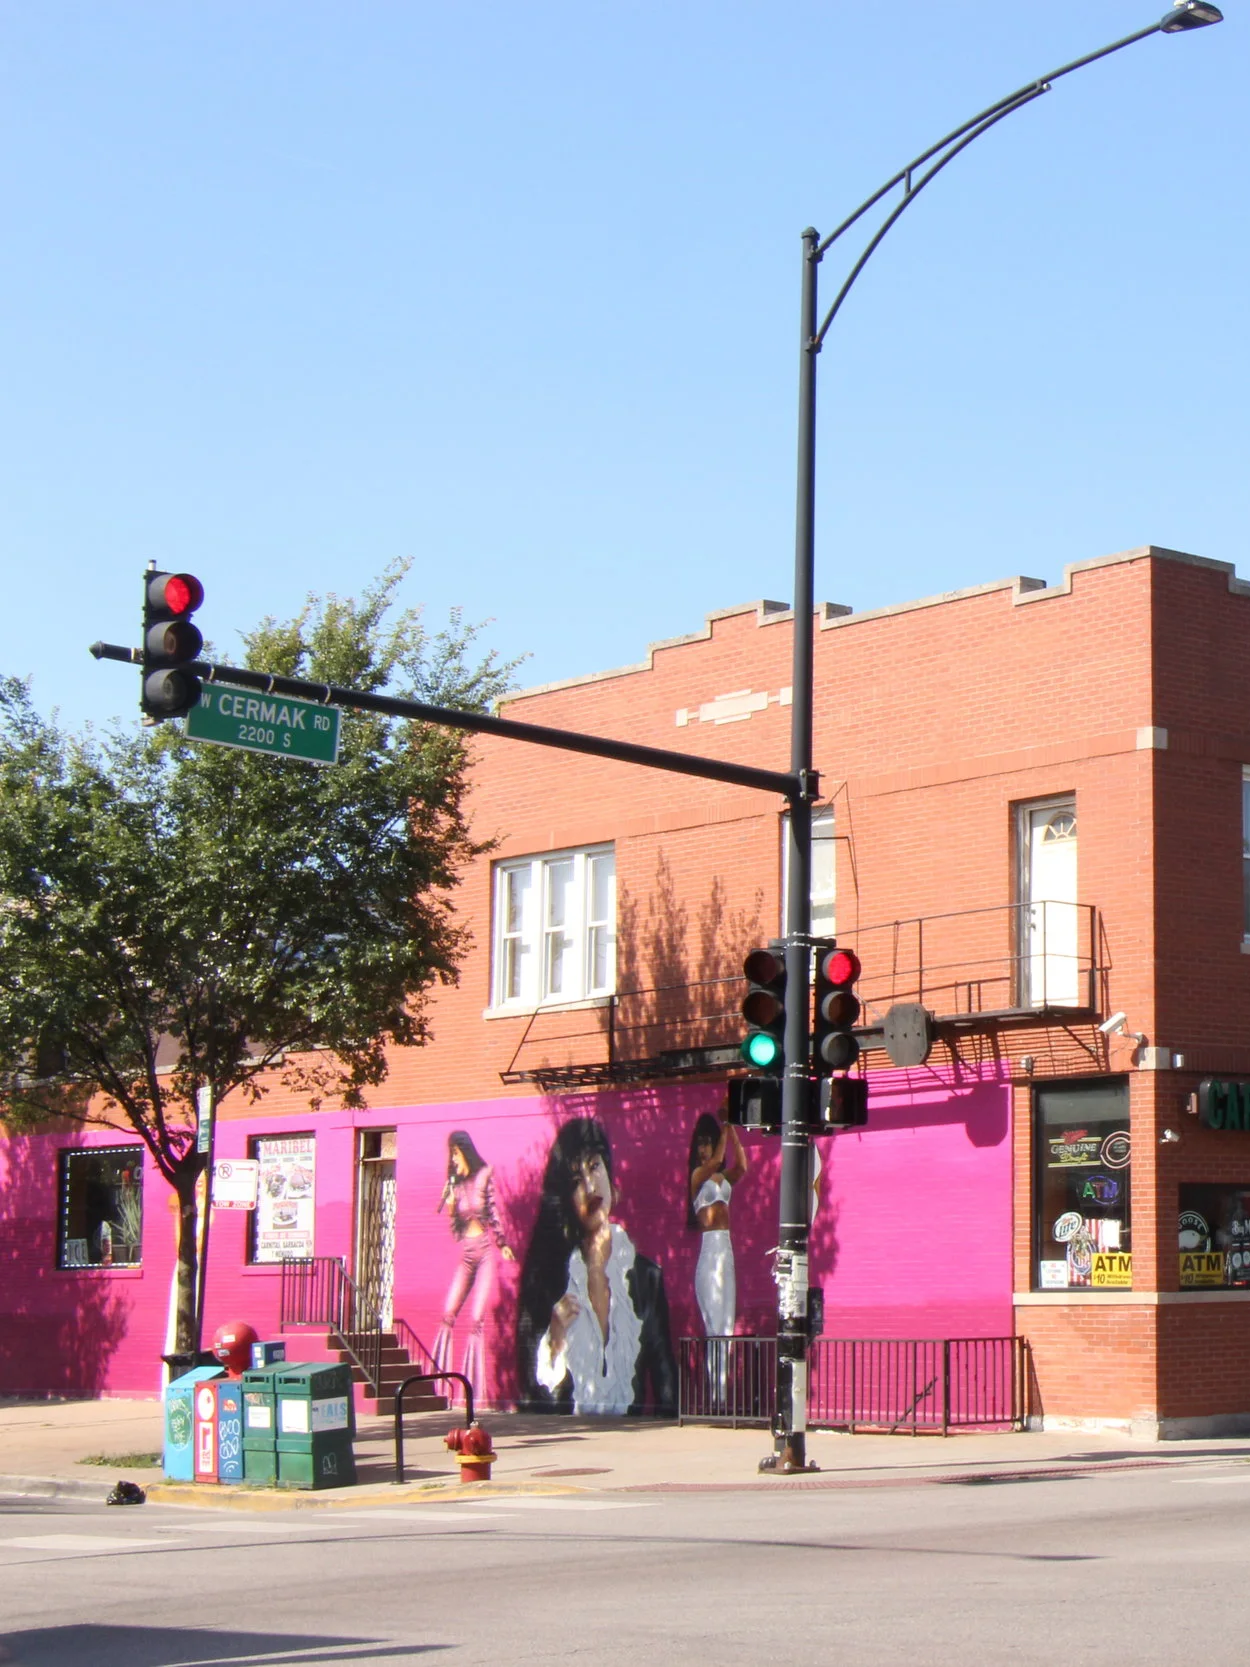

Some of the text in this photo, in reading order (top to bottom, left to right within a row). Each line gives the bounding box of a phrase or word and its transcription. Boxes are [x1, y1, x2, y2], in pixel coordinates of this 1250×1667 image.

[200, 692, 331, 731] W CERMAK RD
[238, 724, 291, 748] 2200 S
[263, 1139, 313, 1156] MARIBEL
[1050, 1143, 1097, 1154] GENUINE
[1082, 1182, 1118, 1199] ATM
[1095, 1256, 1132, 1272] ATM
[1182, 1255, 1221, 1272] ATM
